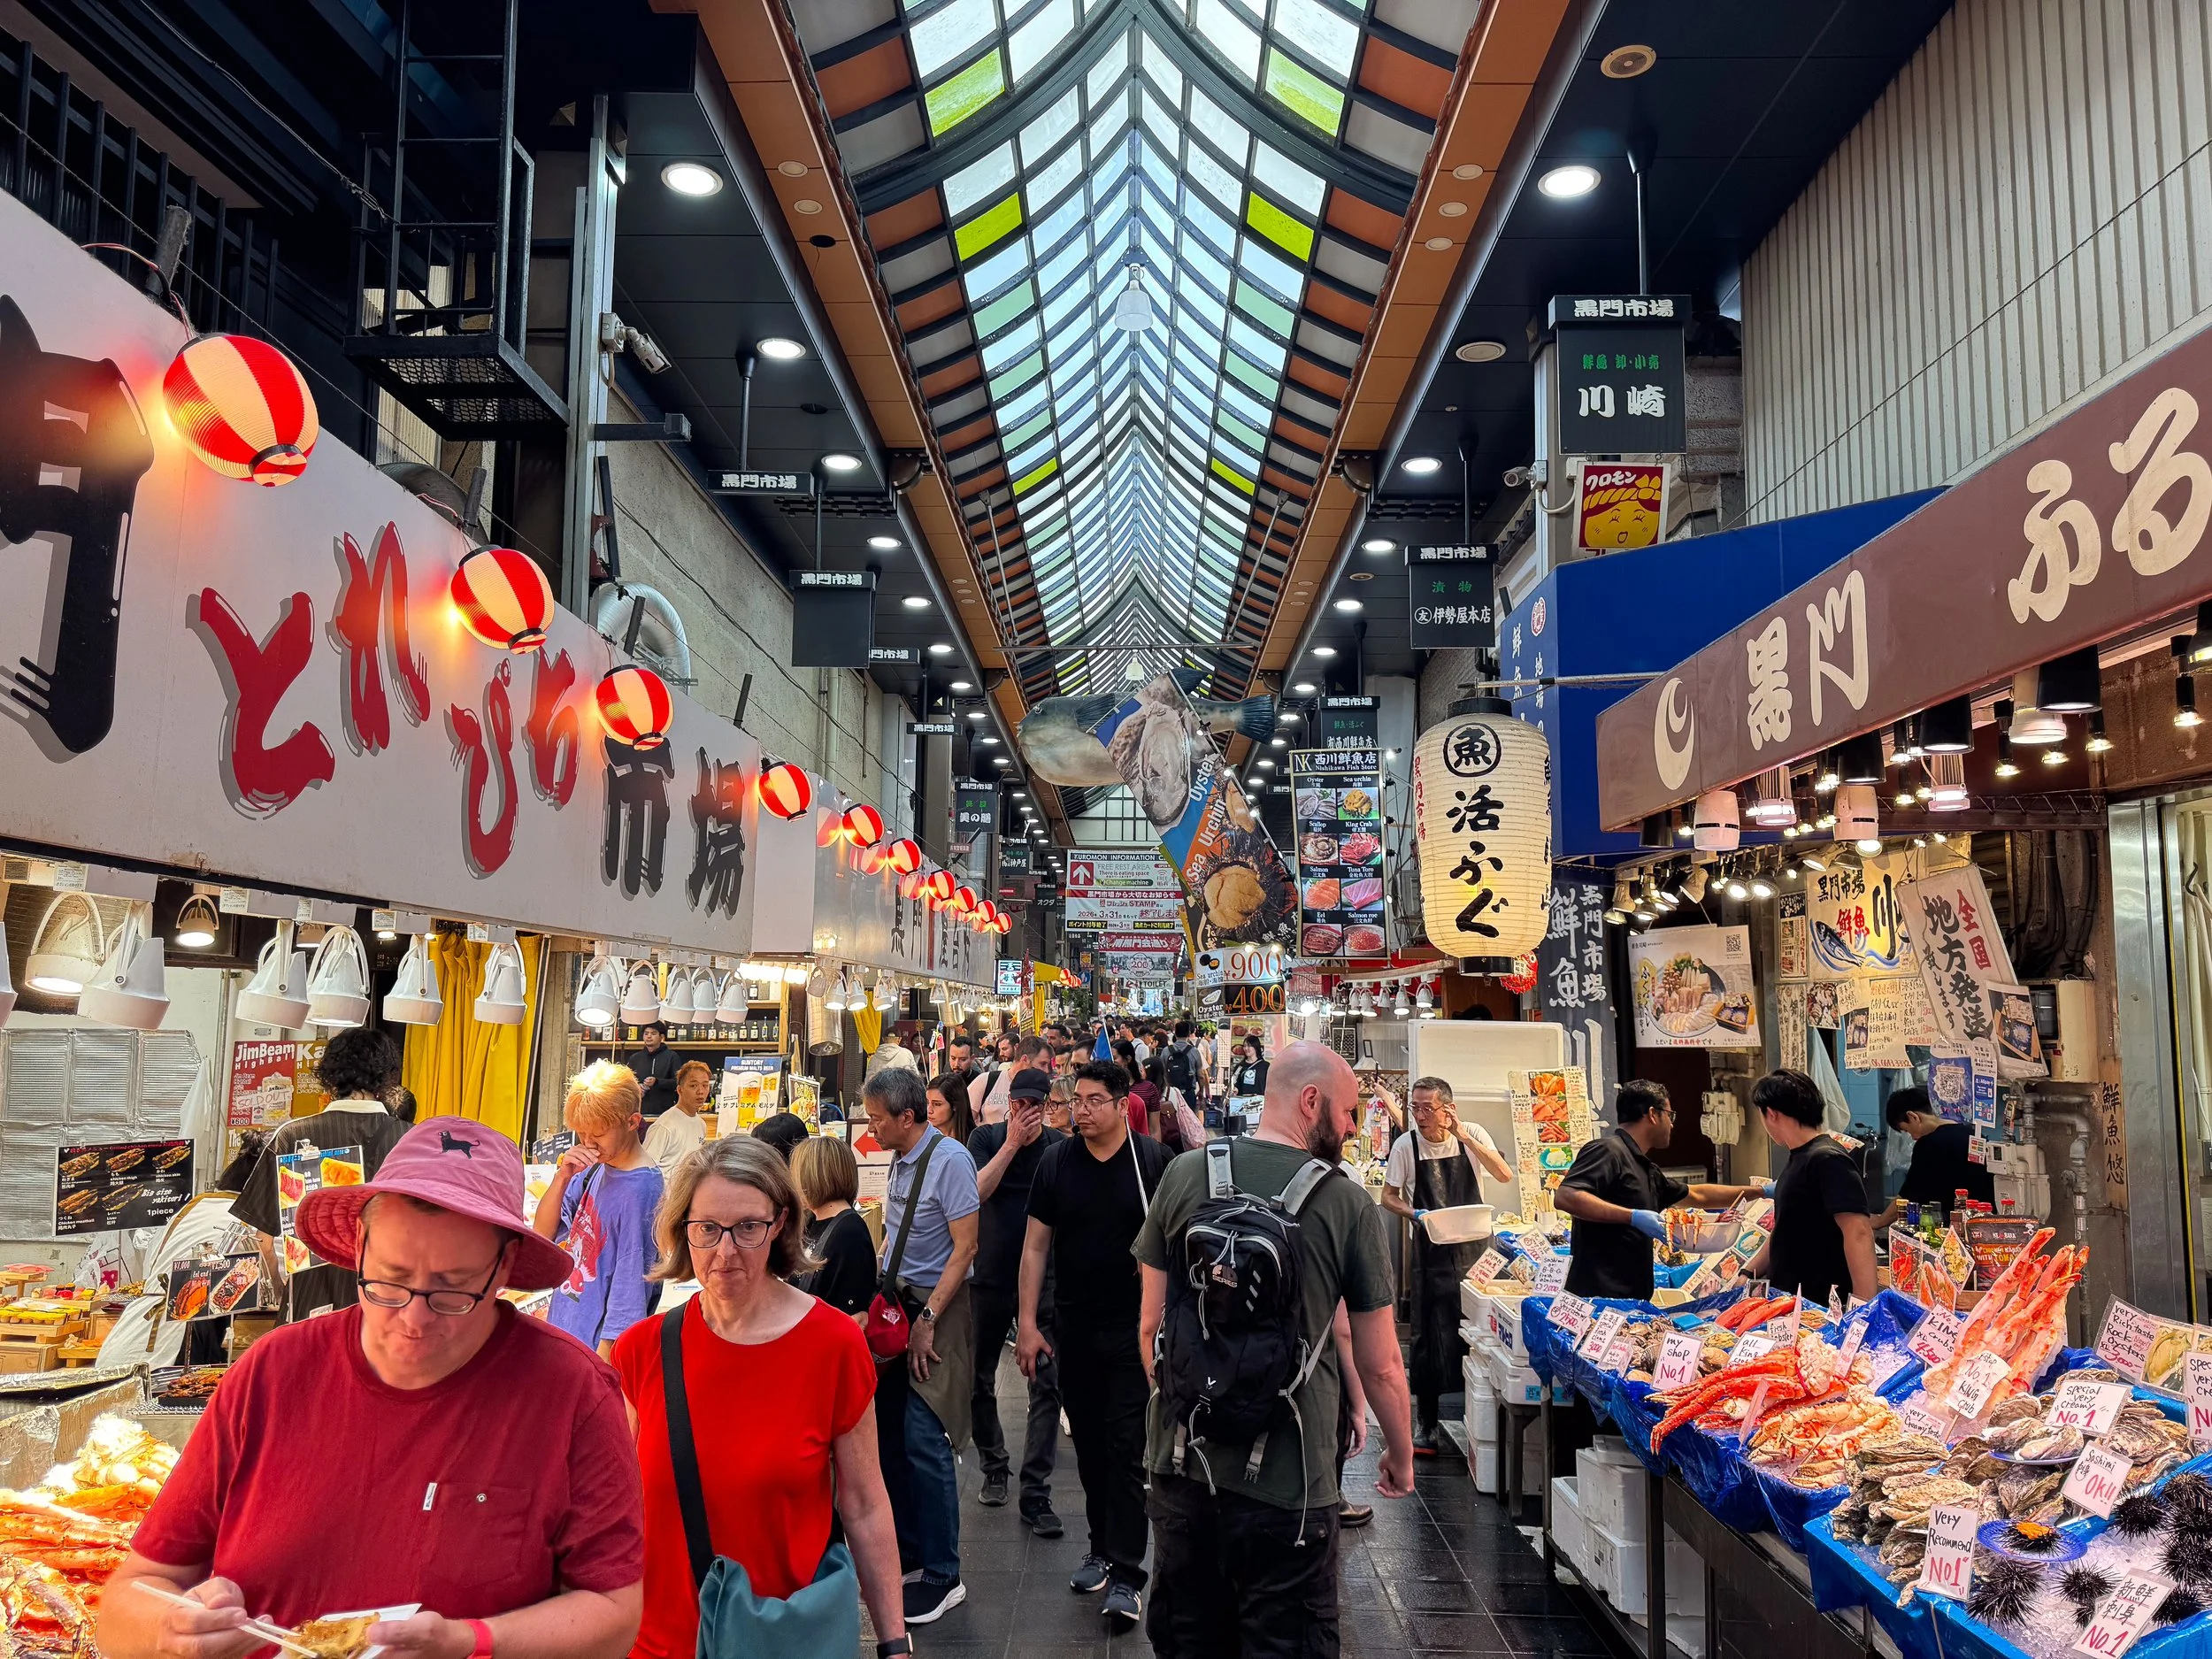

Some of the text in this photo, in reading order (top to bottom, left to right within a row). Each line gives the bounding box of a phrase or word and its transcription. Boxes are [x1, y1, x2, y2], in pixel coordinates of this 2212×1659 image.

[1574, 299, 1674, 317] 黒門市場
[1583, 355, 1608, 370] 鮮魚
[1578, 384, 1666, 418] 川崎
[722, 473, 797, 489] 黒門市場
[1586, 471, 1636, 491] クロモン
[1420, 546, 1486, 559] 黒門市場
[801, 573, 862, 585] 黒門市場
[1432, 581, 1472, 594] 漬物
[1433, 605, 1491, 625] 伊勢屋本店
[870, 649, 909, 659] 門市場
[1328, 697, 1372, 707] 黒門市場
[913, 724, 955, 733] 黒門市場
[1315, 753, 1377, 764] 西川鮮魚店
[1189, 755, 1215, 802] Oyster
[1186, 796, 1226, 883] Sea Urchin
[1446, 784, 1509, 938] 活ふぐ
[1817, 871, 1866, 902] 黒門市場
[1837, 906, 1870, 944] 鮮魚
[1957, 889, 1991, 970] 全国
[1547, 887, 1585, 1009] 鮮魚
[1581, 885, 1607, 1002] 黒門市場
[1924, 895, 1992, 1041] 地方発送
[1198, 1004, 1224, 1014] Oyster
[234, 1043, 296, 1063] JimBeam
[238, 1094, 264, 1108] SOLD
[265, 1090, 289, 1103] OUT
[142, 1188, 156, 1197] Big
[1667, 1337, 1684, 1348] my
[2107, 1323, 2132, 1343] Rock
[1743, 1339, 1759, 1349] all
[1667, 1348, 1690, 1362] shop
[1958, 1380, 1979, 1401] KING
[2073, 1394, 2096, 1404] very
[2085, 1449, 2117, 1472] Sashimi
[1935, 1509, 1962, 1531] Very
[1928, 1527, 1974, 1554] Recommend
[2116, 1578, 2158, 1607] 新鮮
[2101, 1600, 2135, 1625] 刺身
